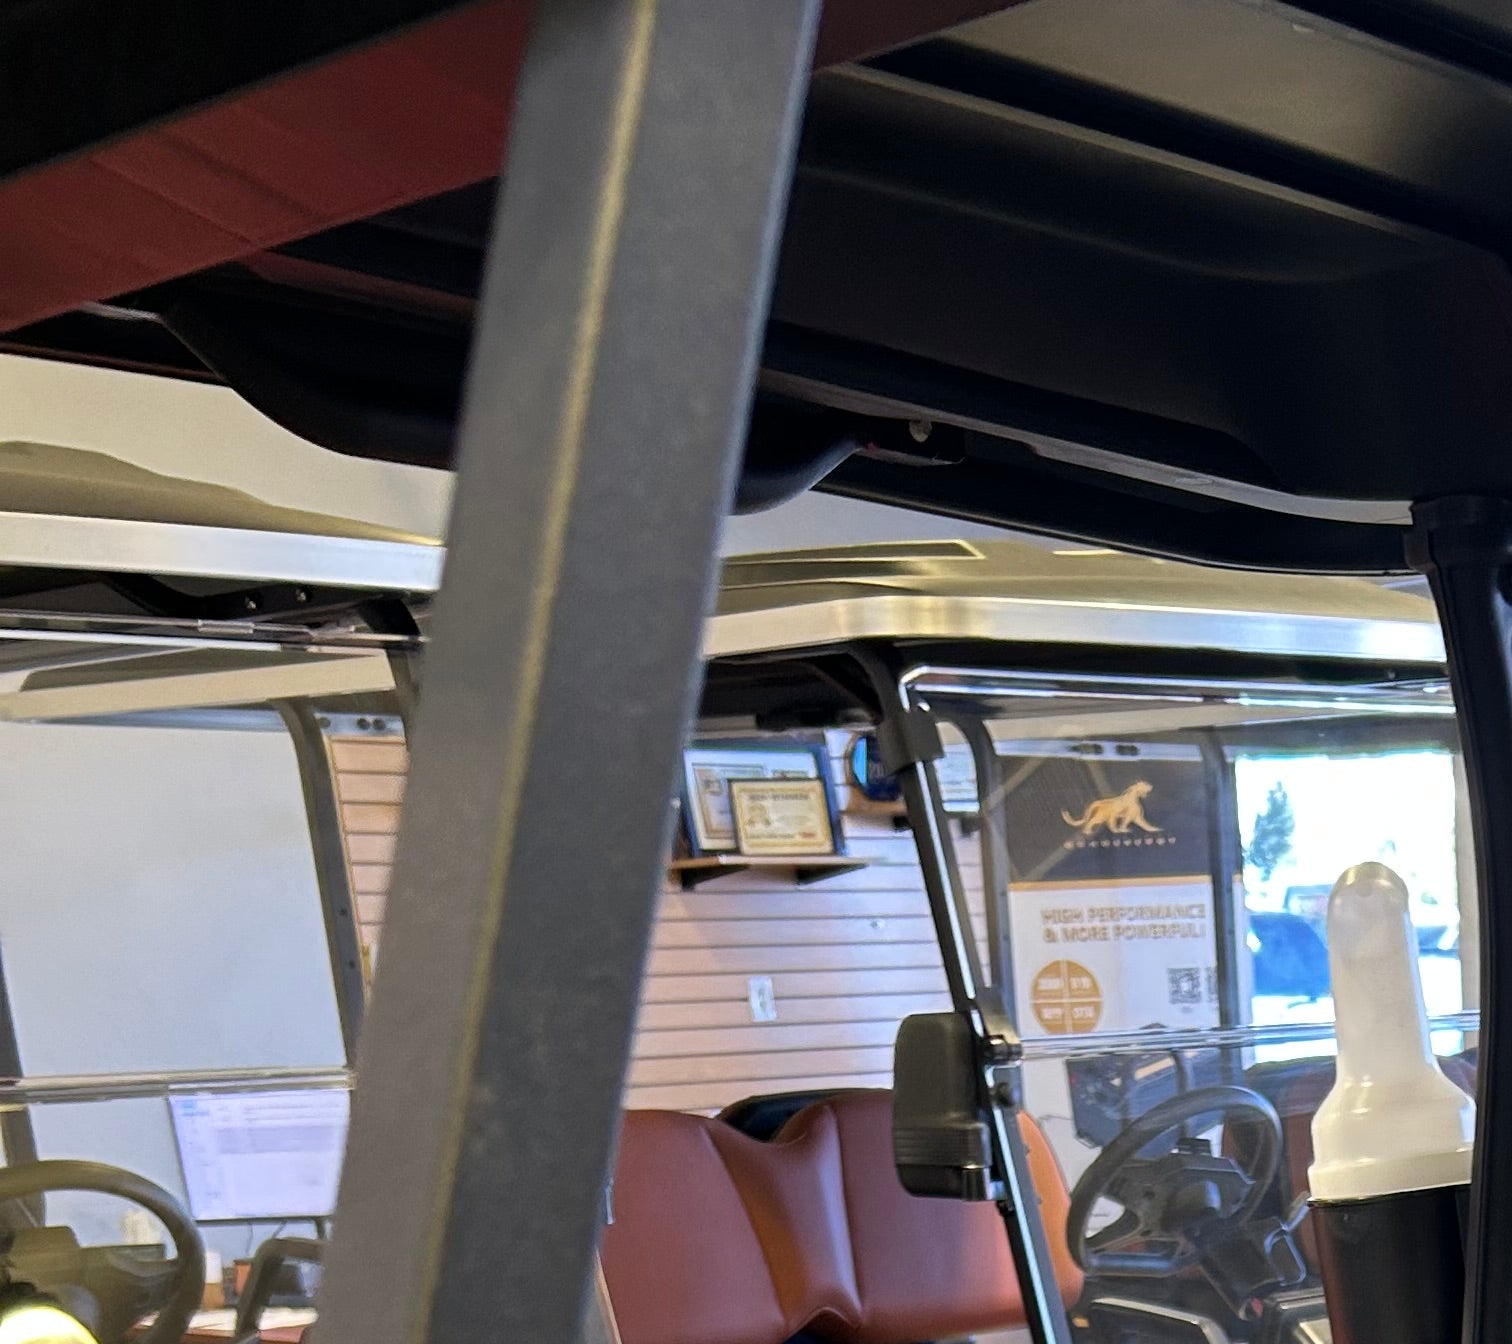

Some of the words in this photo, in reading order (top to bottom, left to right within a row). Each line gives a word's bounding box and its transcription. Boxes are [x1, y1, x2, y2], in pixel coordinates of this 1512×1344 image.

[1041, 908, 1084, 925] HIGH
[1088, 904, 1206, 922] PERFORMANCE
[1043, 927, 1058, 943] &
[1063, 924, 1110, 942] MORE
